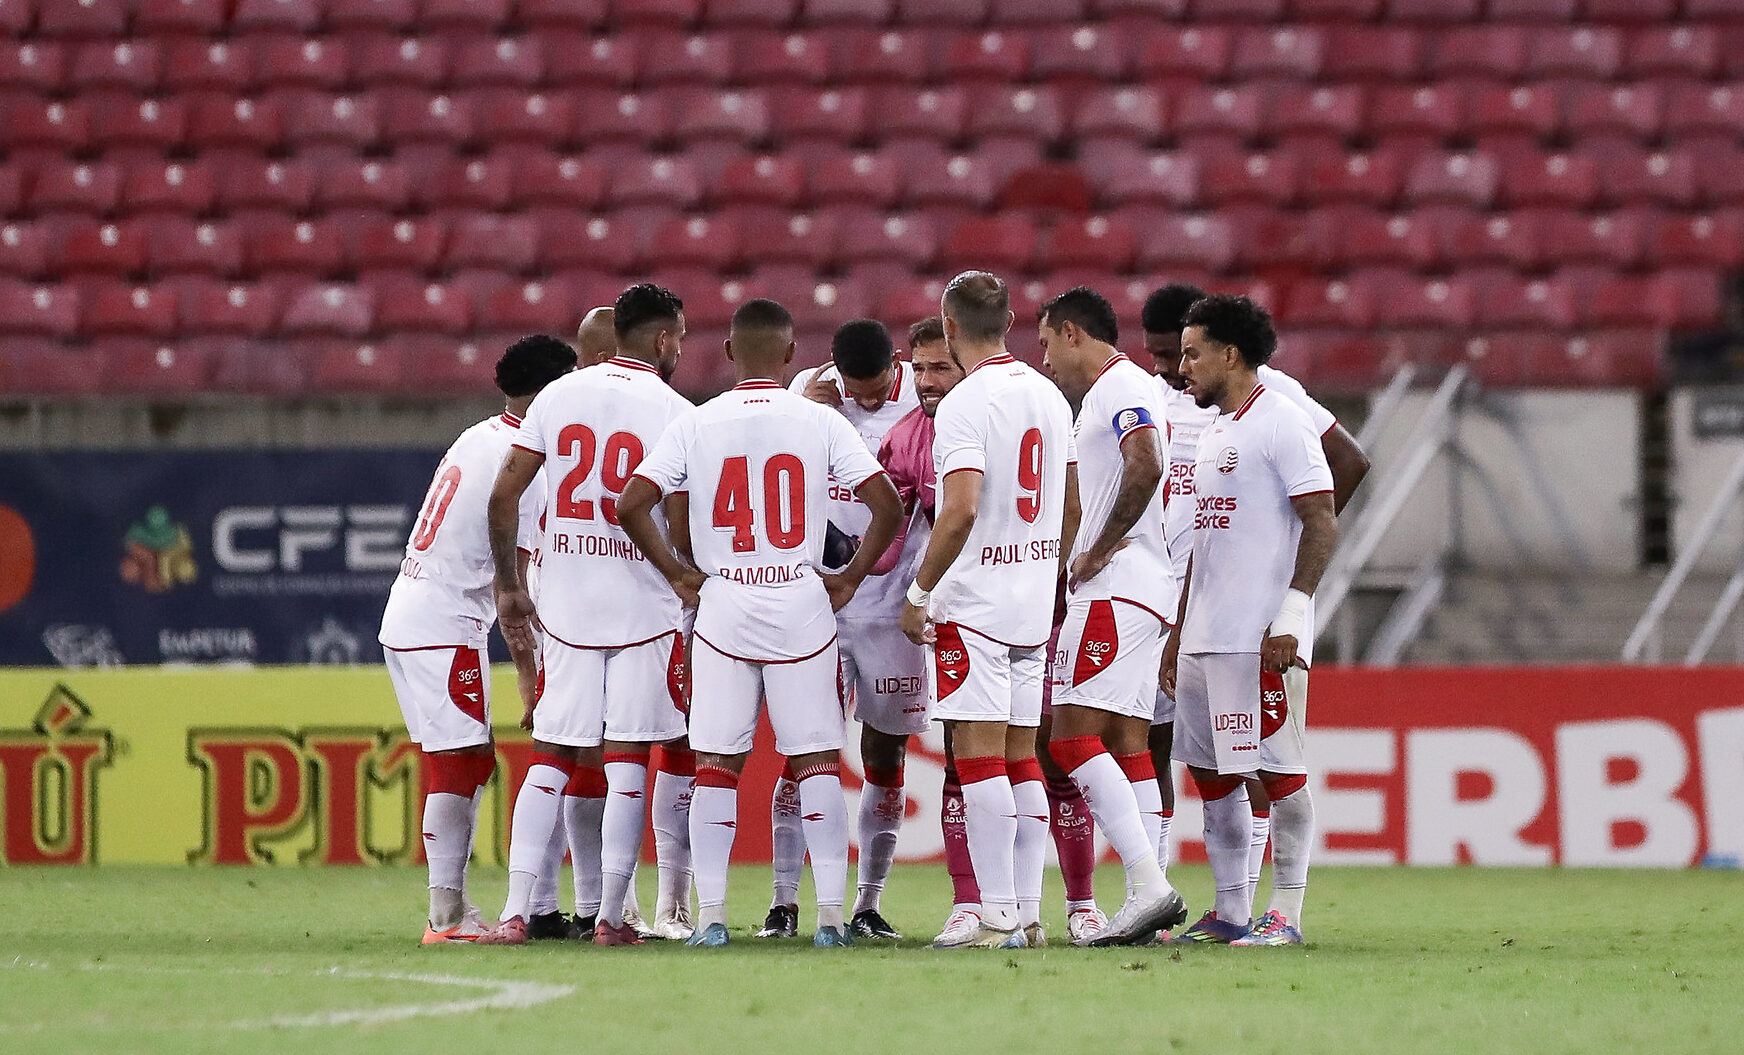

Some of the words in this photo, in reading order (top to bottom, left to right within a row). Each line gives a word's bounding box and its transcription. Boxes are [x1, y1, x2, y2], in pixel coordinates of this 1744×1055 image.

[557, 424, 644, 527] 29
[713, 454, 806, 553] 40
[1016, 428, 1043, 524] 9
